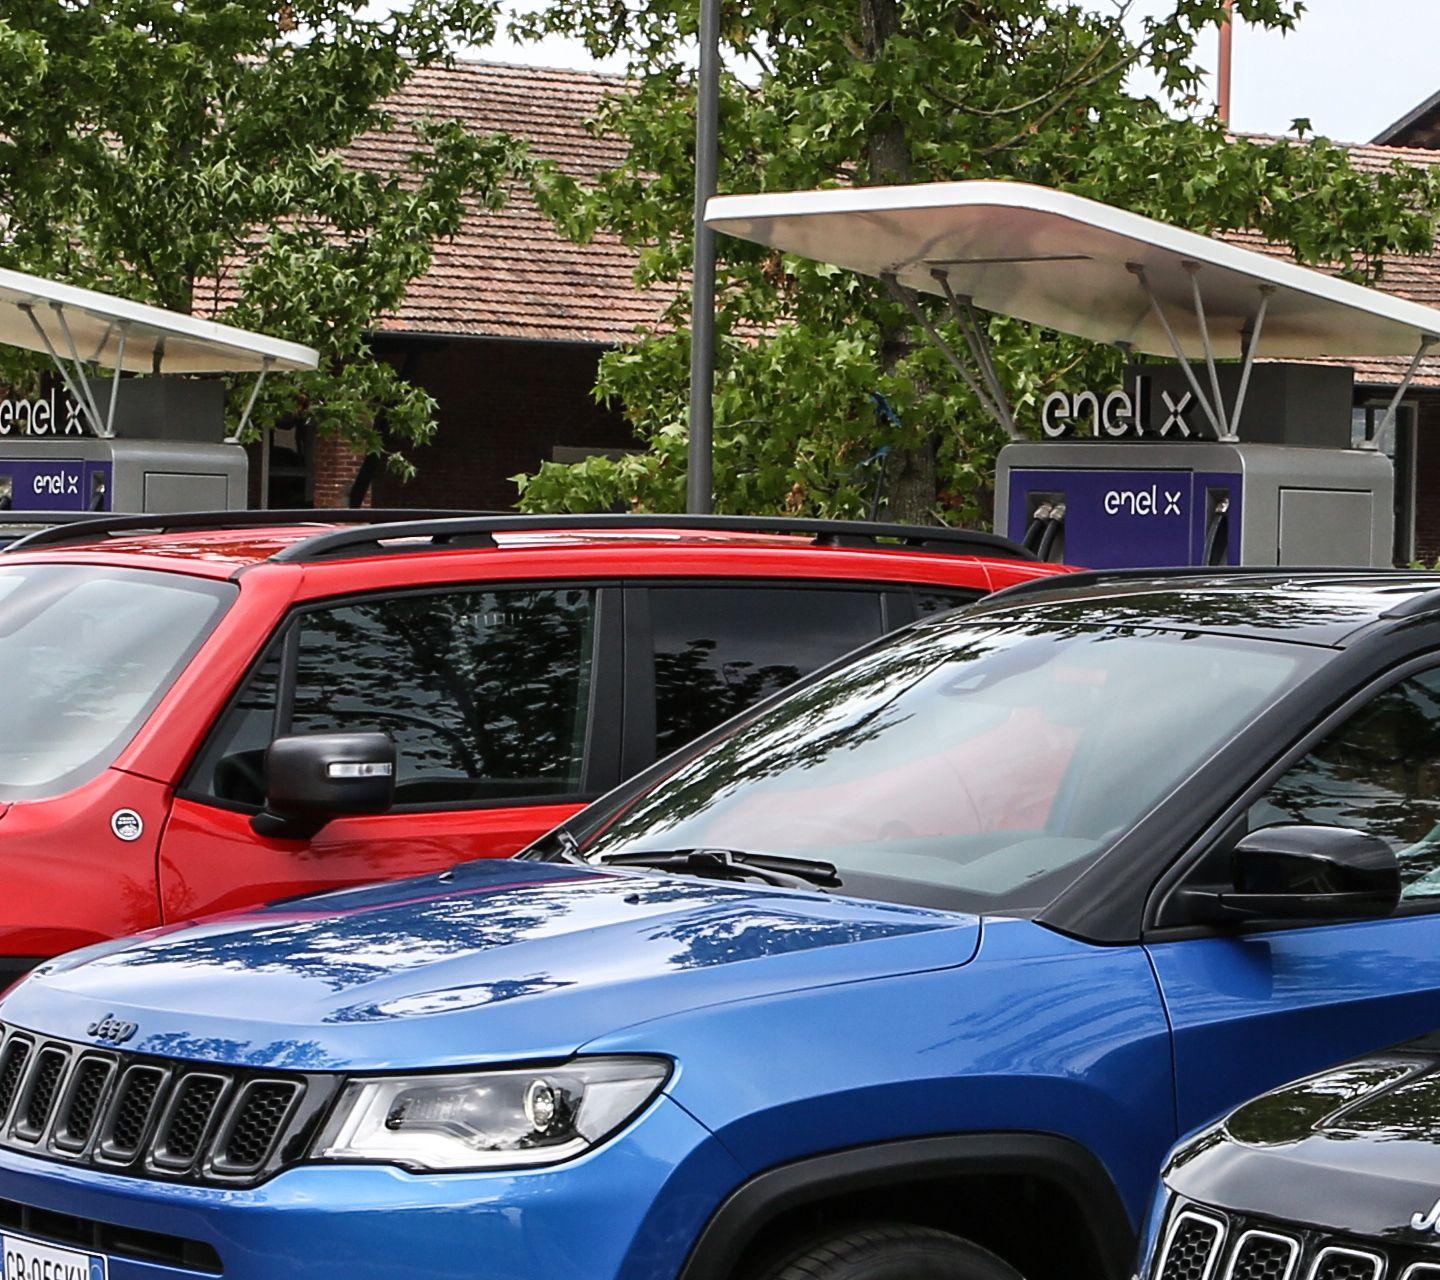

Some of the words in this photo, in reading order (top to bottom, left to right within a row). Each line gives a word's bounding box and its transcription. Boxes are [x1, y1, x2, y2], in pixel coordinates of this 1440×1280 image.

[1042, 375, 1144, 437] enel
[1160, 390, 1192, 437] x
[33, 471, 65, 494] enel
[1104, 485, 1157, 515] enel
[1164, 491, 1182, 515] x
[87, 1013, 139, 1046] Jeep
